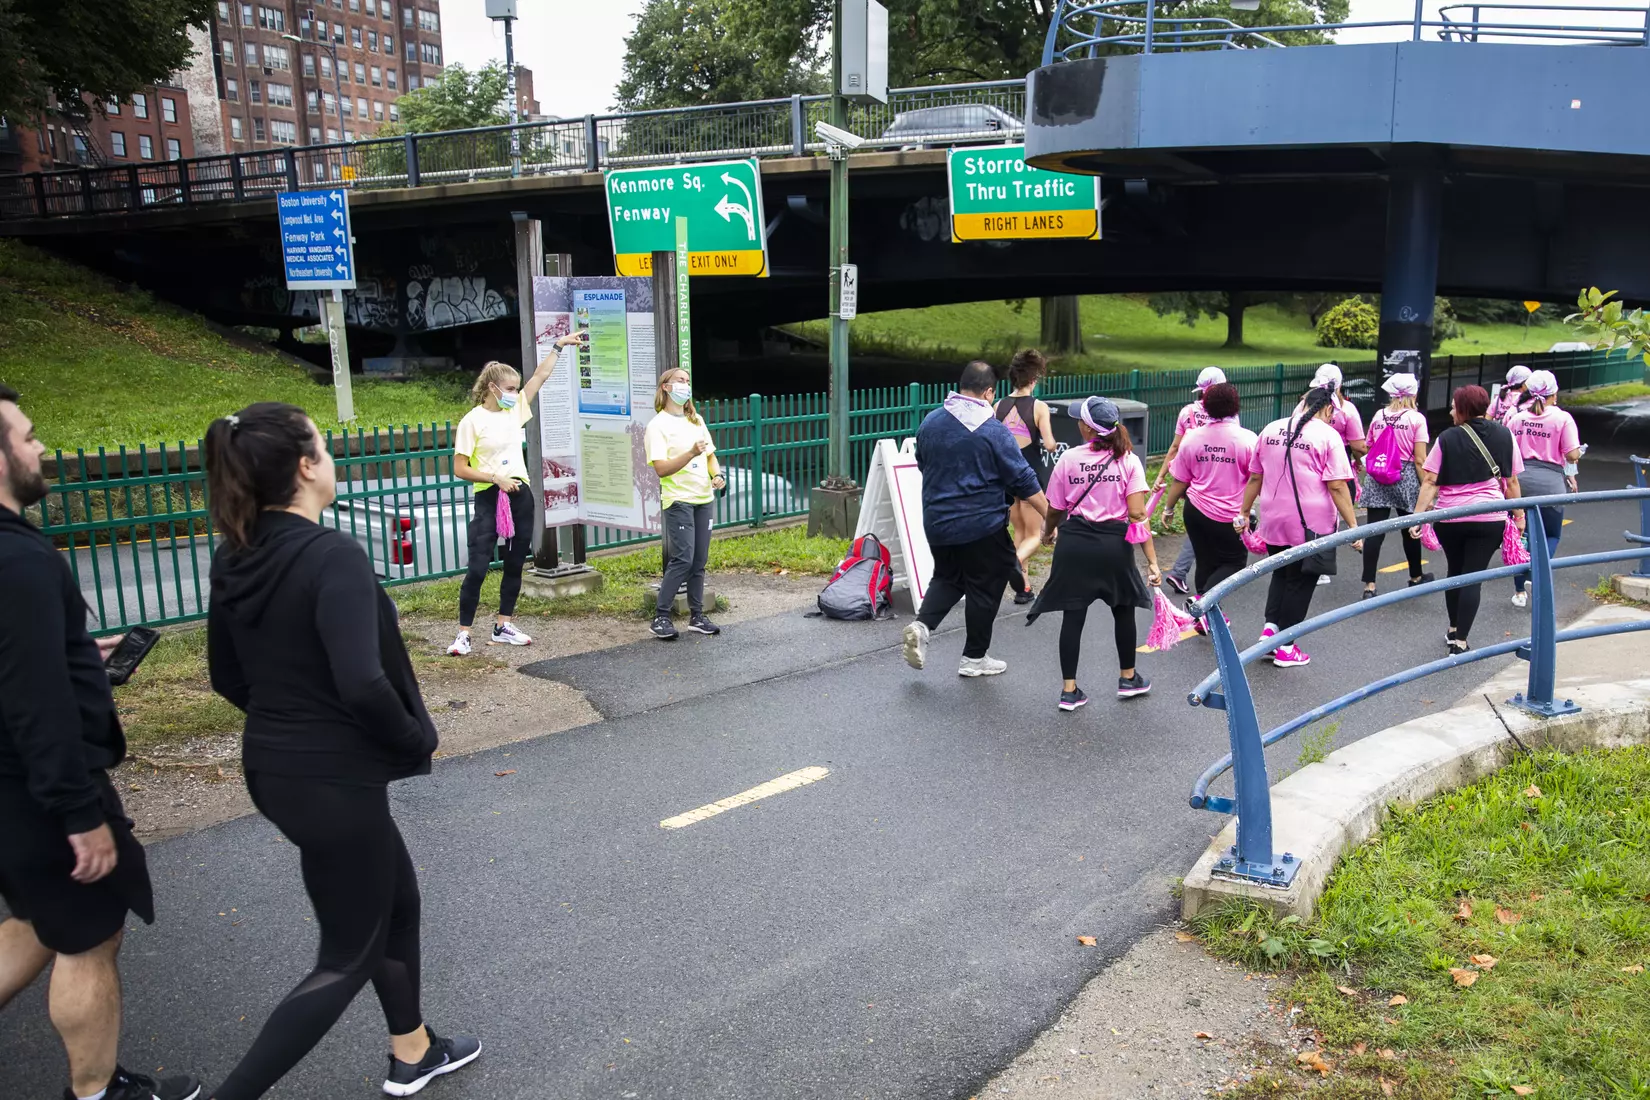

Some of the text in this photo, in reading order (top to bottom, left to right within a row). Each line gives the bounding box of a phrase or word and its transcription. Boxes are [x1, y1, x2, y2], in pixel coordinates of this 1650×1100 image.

[611, 172, 706, 194] Kenmore Sq.
[966, 178, 1075, 200] Thru Traffic
[280, 195, 327, 207] Boston University
[282, 216, 303, 226] Longwood
[314, 214, 324, 224] Area
[614, 206, 671, 224] Fenway
[984, 215, 1064, 231] RIGHT LANES
[284, 231, 325, 244] Fenway Park
[286, 245, 332, 254] HARVARD VANGUARD
[307, 254, 335, 262] ASSOCIATES
[691, 256, 710, 269] EXIT
[715, 255, 738, 268] ONLY
[314, 266, 333, 278] University
[583, 293, 623, 301] ESPLANADE
[678, 241, 690, 373] THE CHARLES RIVE
[1521, 419, 1543, 428] Team
[1526, 428, 1551, 438] Rosas
[1266, 437, 1280, 446] Las
[1203, 444, 1226, 453] Team
[1195, 455, 1236, 464] Las Rosas
[1068, 473, 1121, 485] Las Rosas
